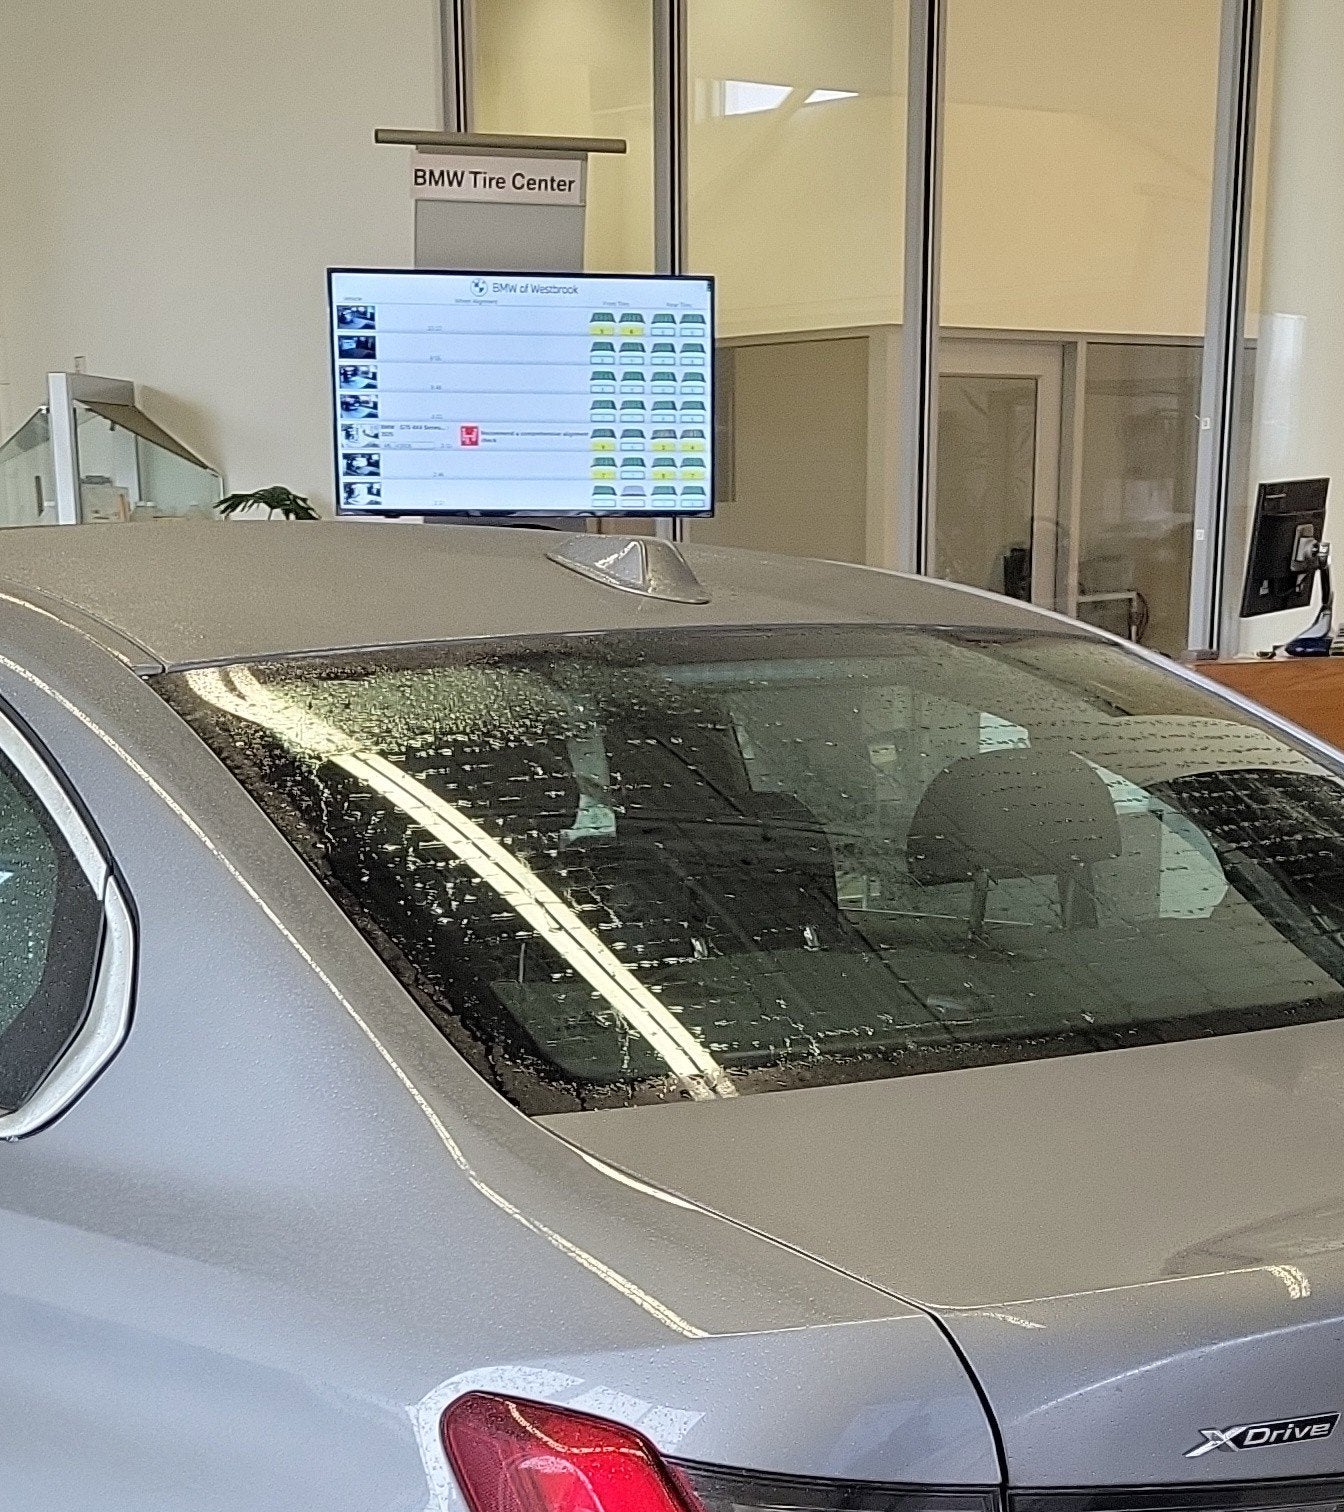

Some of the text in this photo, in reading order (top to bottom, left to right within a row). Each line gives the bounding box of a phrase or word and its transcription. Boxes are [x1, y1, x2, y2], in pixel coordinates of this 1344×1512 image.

[413, 168, 576, 193] BMW Tire Center
[492, 282, 579, 295] BMW of Westbrook
